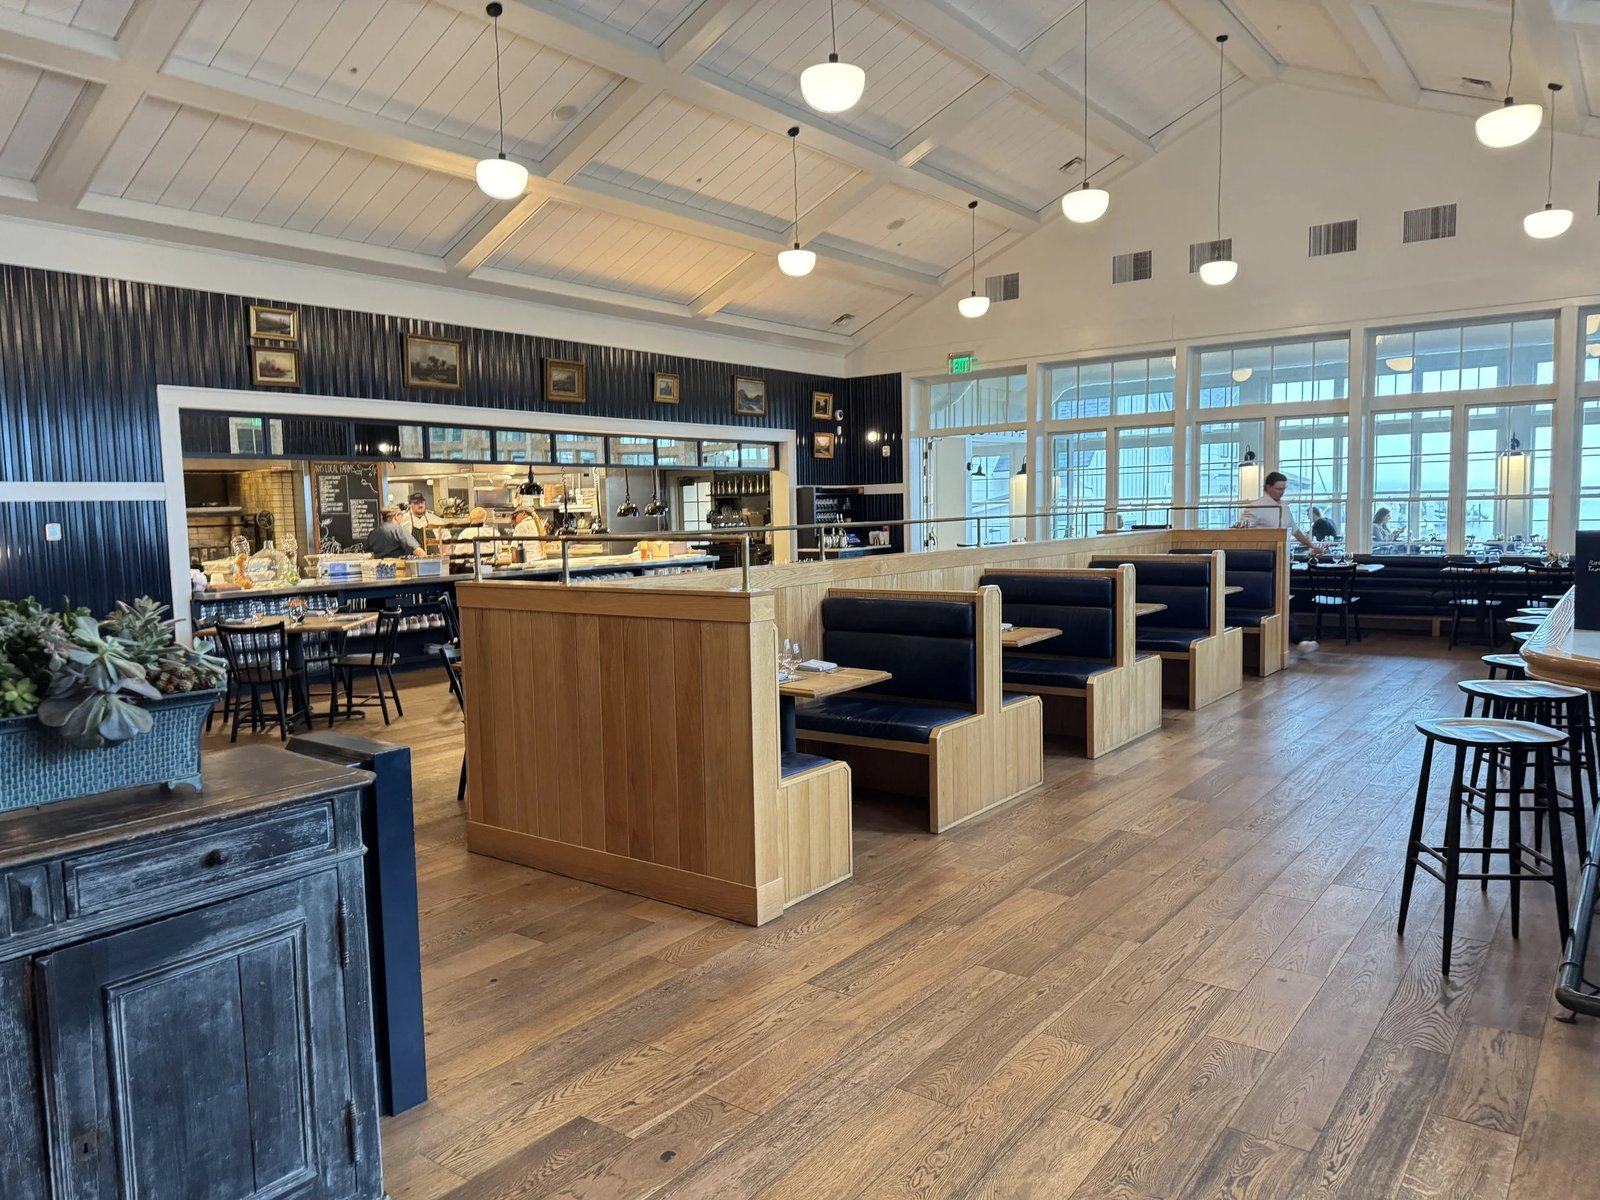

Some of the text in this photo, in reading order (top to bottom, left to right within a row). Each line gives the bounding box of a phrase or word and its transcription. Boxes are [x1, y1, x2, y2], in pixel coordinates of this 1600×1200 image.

[952, 357, 968, 371] EXIT
[325, 464, 339, 473] LOCAL
[340, 464, 355, 473] FARMS
